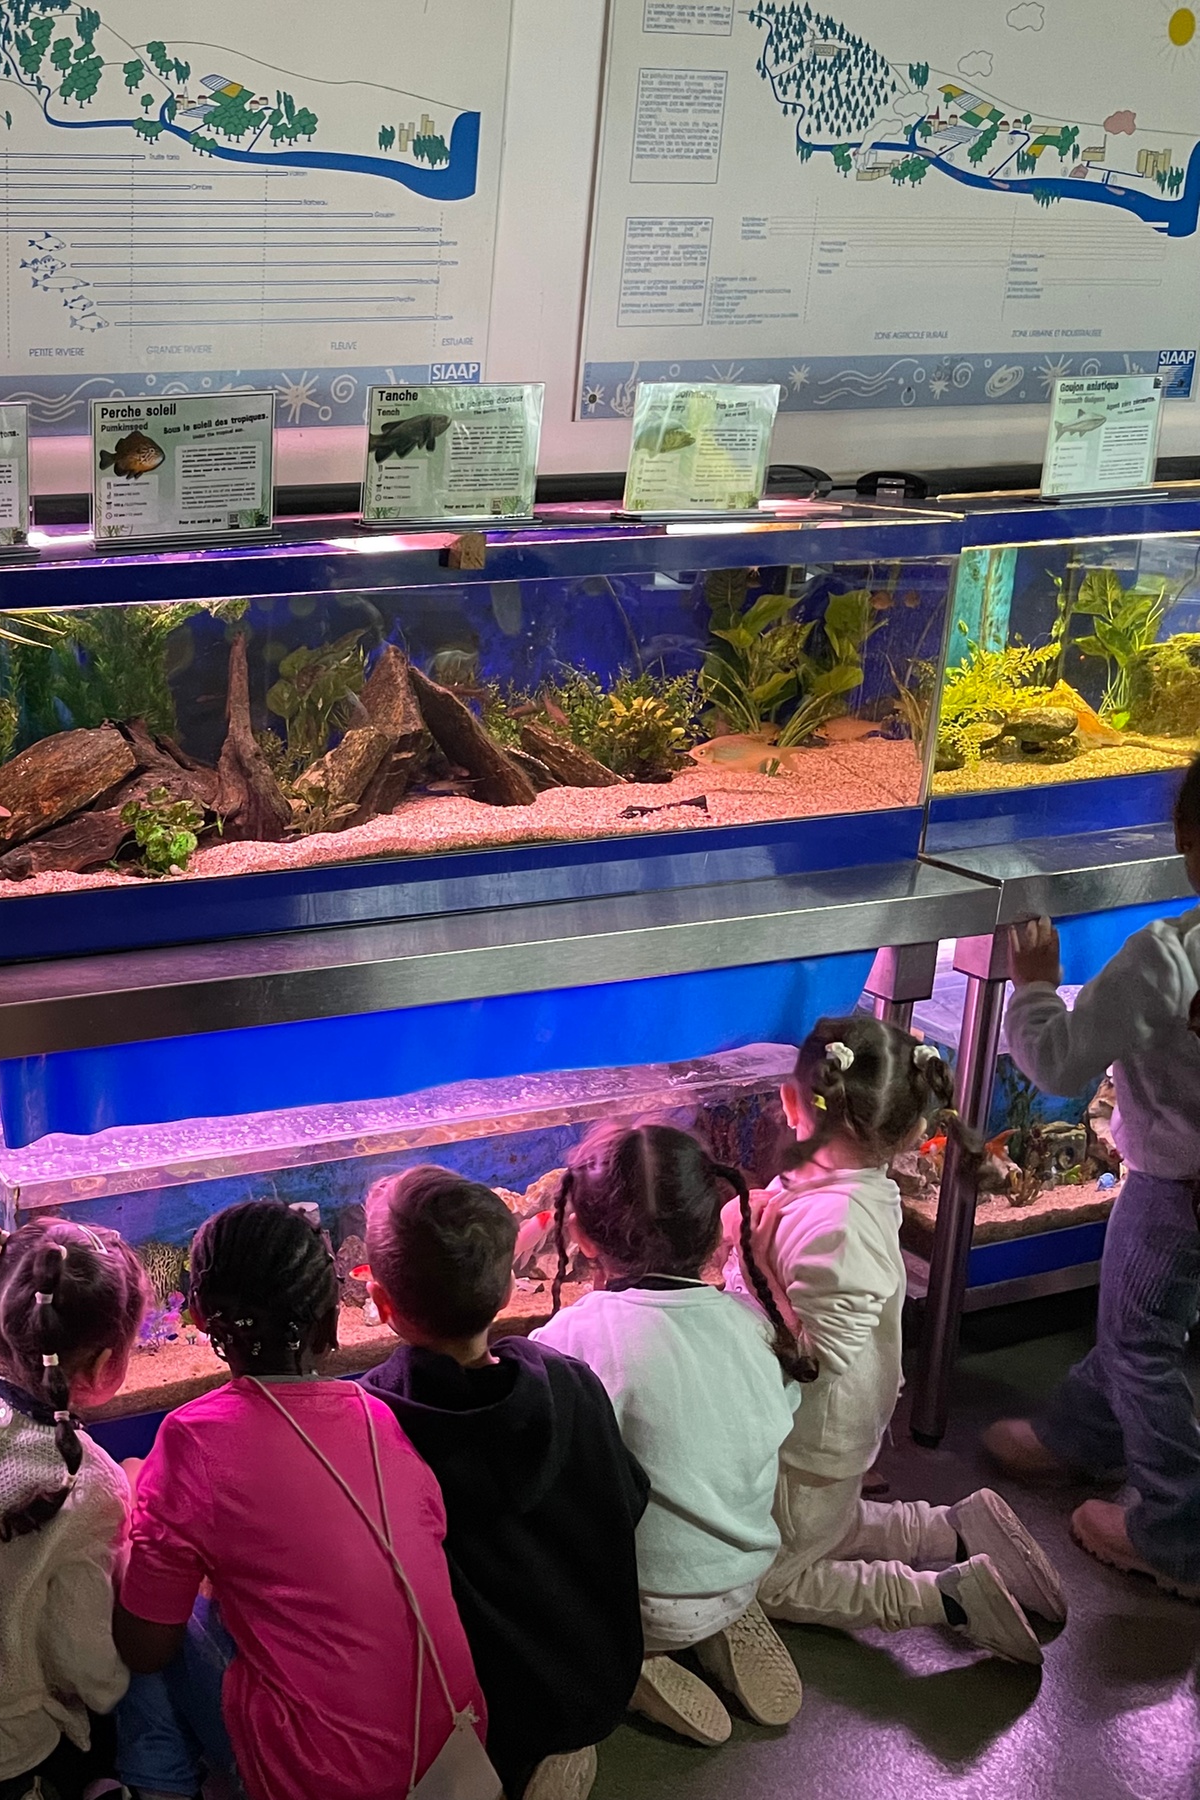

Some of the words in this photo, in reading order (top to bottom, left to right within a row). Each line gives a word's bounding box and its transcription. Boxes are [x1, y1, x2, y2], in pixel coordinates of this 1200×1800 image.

[330, 340, 358, 350] FLEUVE
[29, 348, 53, 357] PETITE
[1159, 351, 1195, 364] SIAAP
[432, 364, 480, 380] SIAAP
[1060, 382, 1084, 394] Goujon
[1086, 380, 1119, 393] asiatique
[378, 390, 418, 402] Tanche
[101, 405, 141, 419] Perche
[146, 403, 177, 416] soleil
[377, 408, 400, 416] Tench
[164, 426, 180, 435] Sous
[184, 424, 190, 432] le
[193, 420, 212, 430] soleil
[215, 418, 228, 427] des
[231, 413, 268, 424] tropiques.
